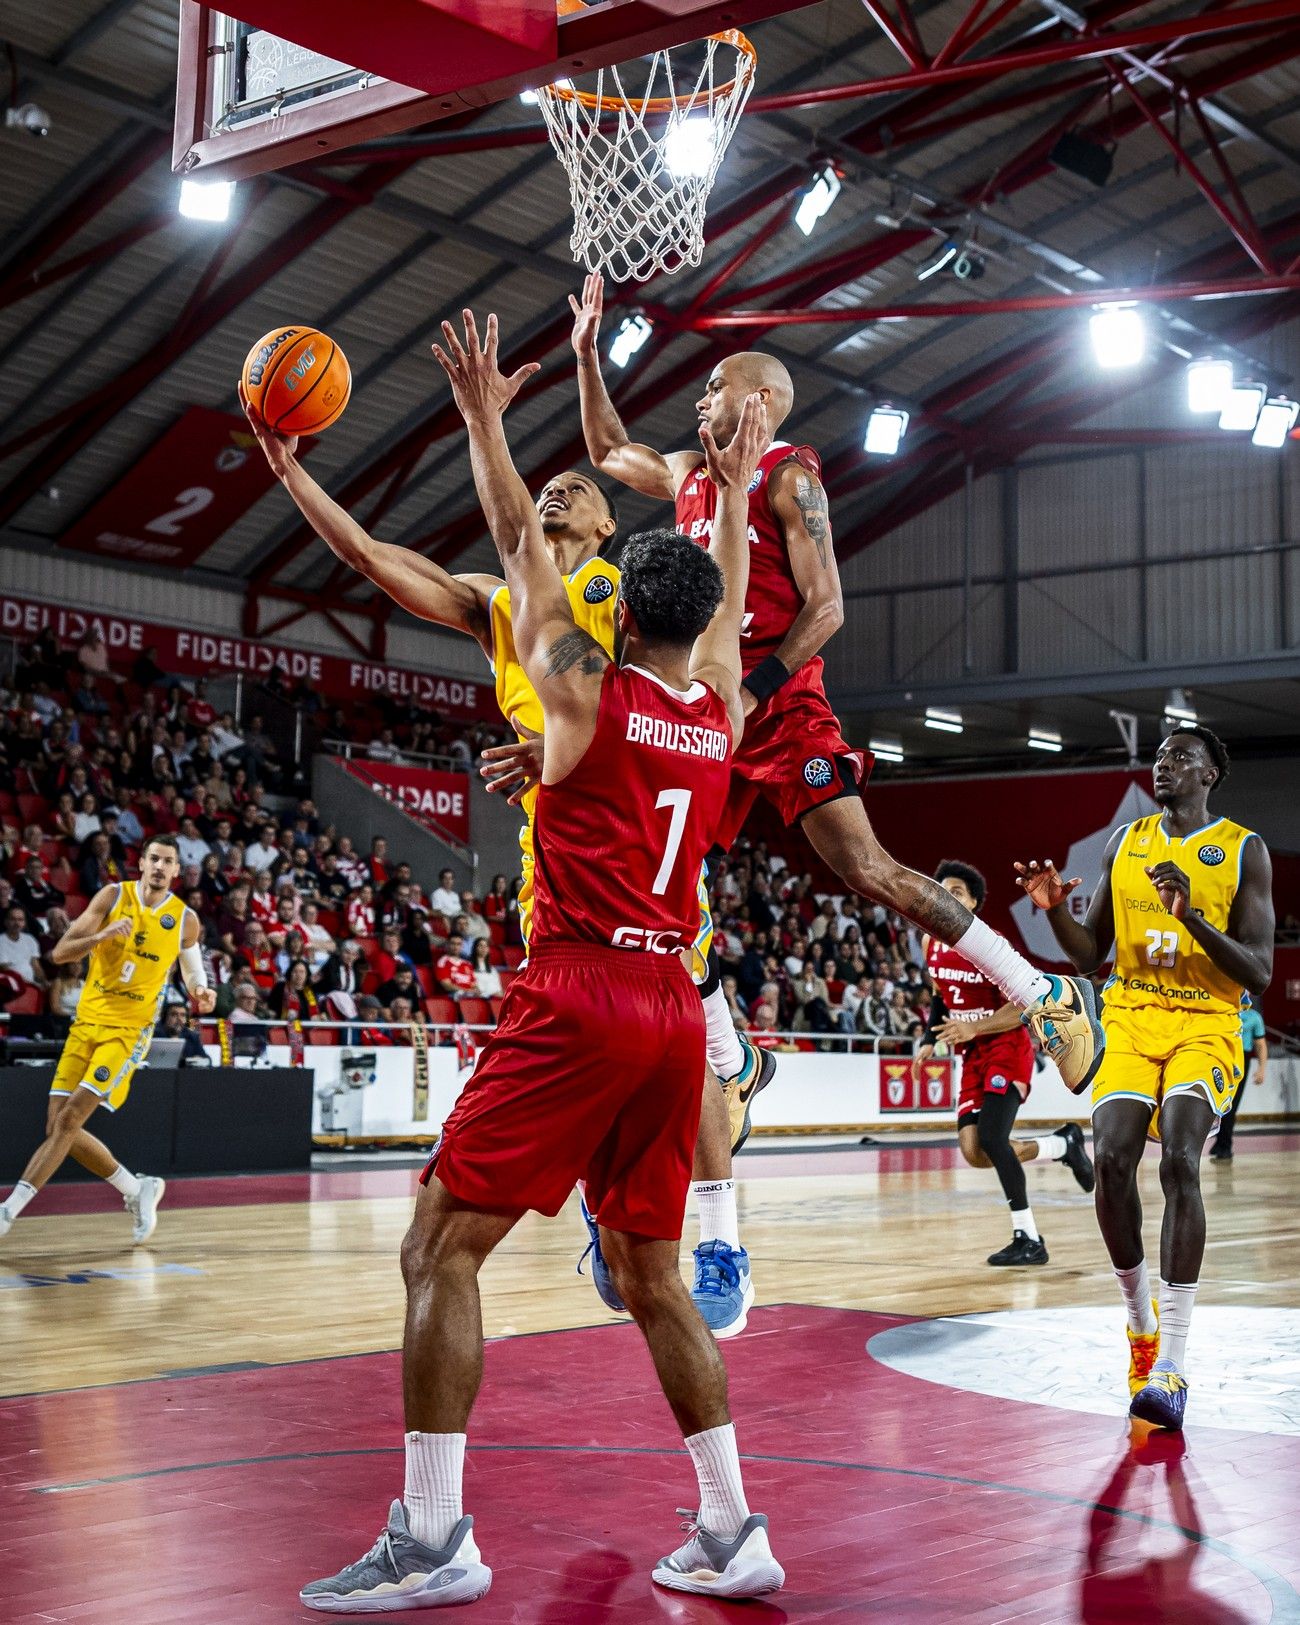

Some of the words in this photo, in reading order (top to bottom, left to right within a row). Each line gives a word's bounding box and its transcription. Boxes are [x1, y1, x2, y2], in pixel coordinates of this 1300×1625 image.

[248, 329, 300, 386] Wilson
[145, 486, 215, 535] 2
[176, 632, 323, 681] FIDELIDADE
[350, 664, 477, 708] FIDELIDADE
[626, 712, 728, 762] BROUSSARD
[1145, 929, 1179, 969] 23
[119, 960, 137, 983] 9
[938, 967, 984, 984] BENFICA
[948, 985, 965, 1004] 2
